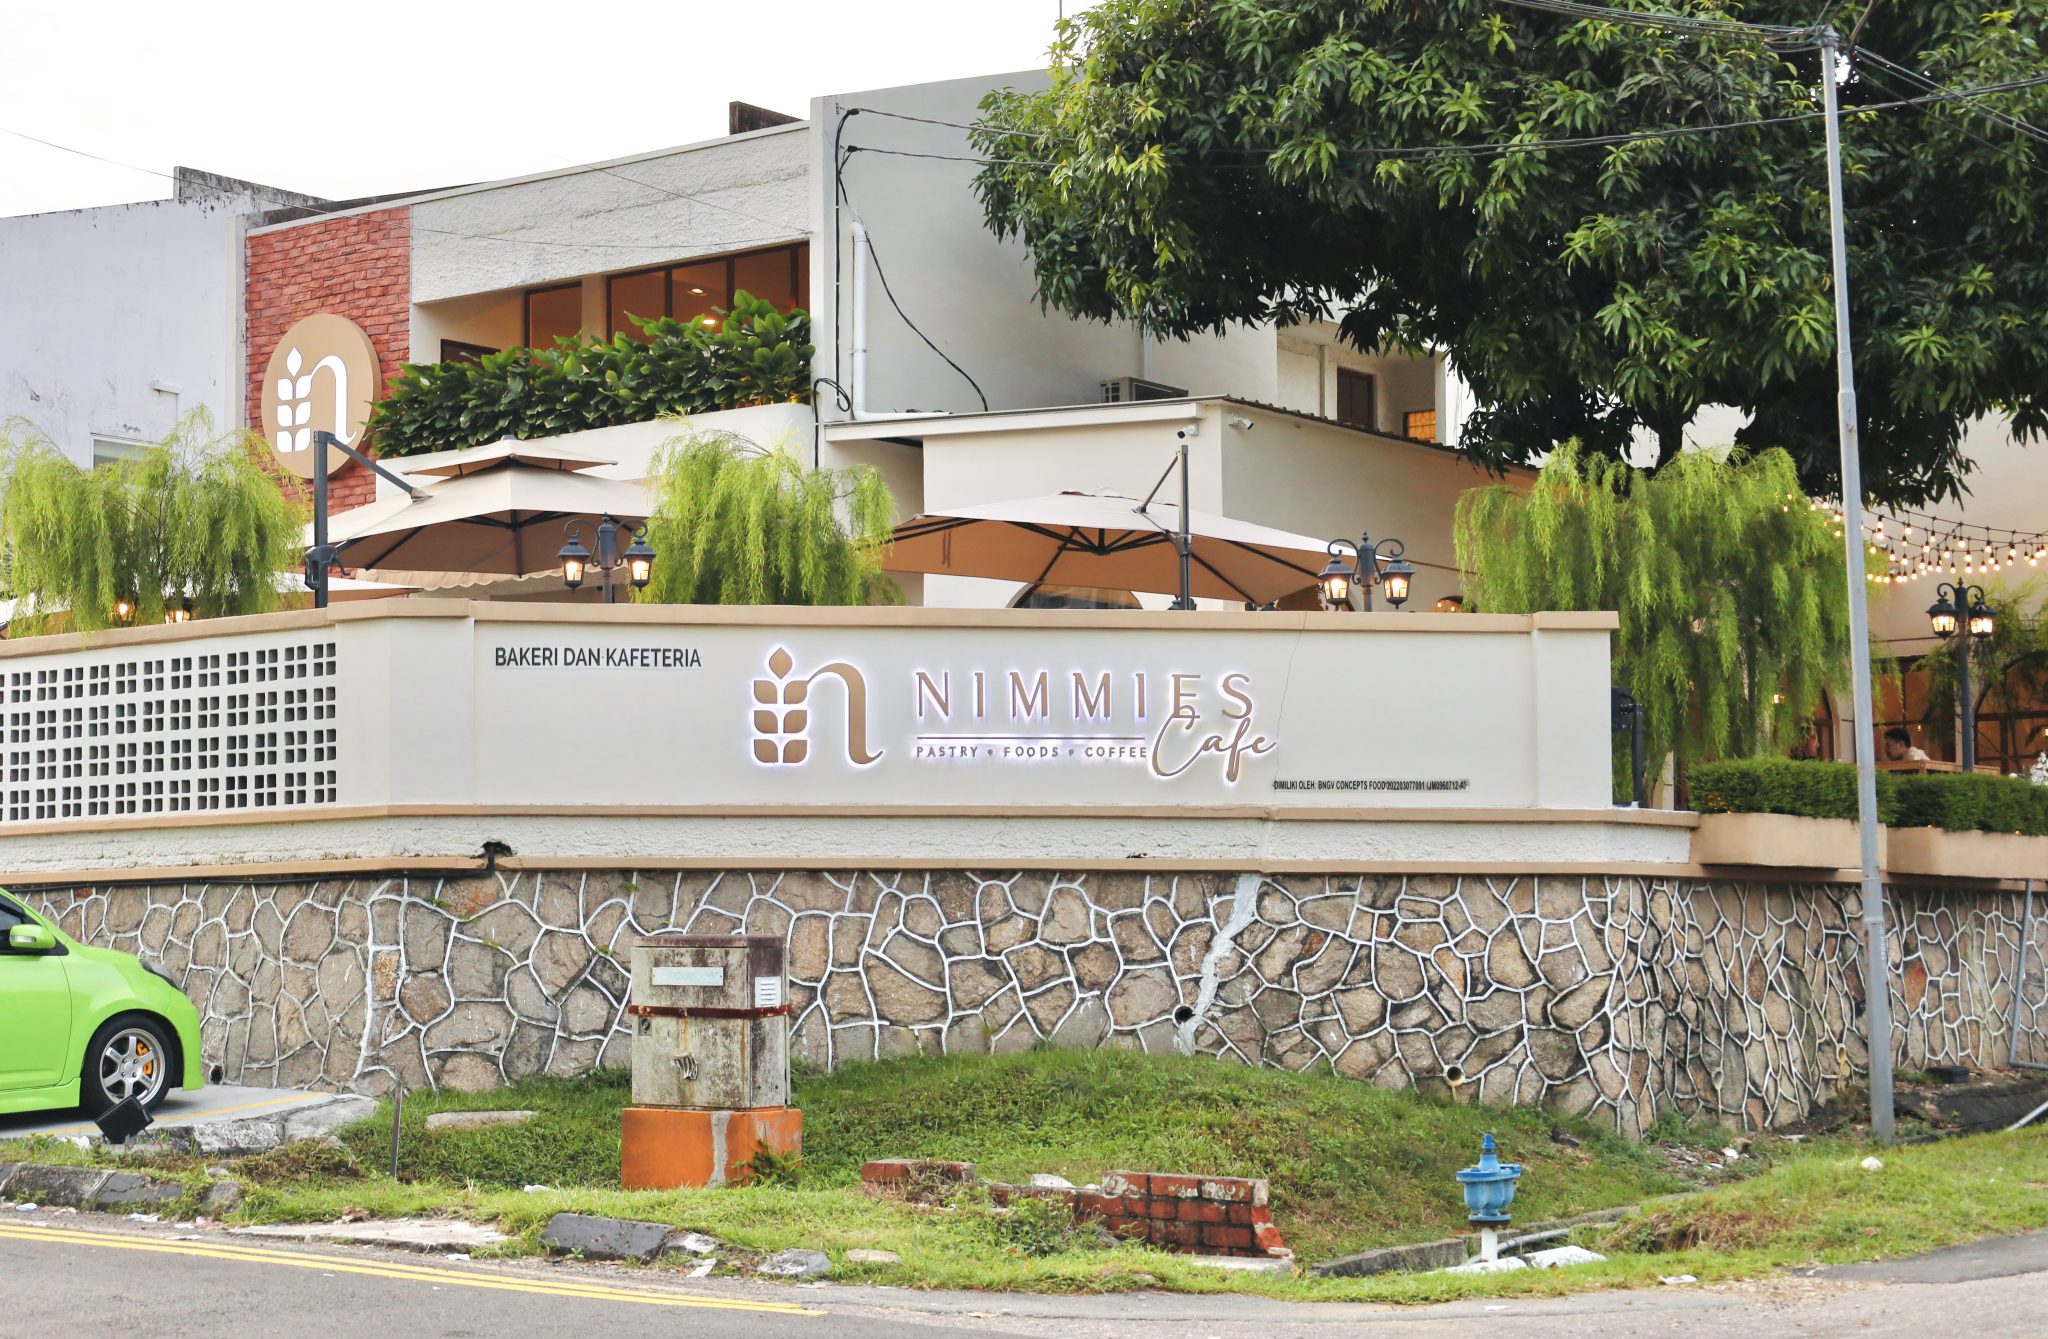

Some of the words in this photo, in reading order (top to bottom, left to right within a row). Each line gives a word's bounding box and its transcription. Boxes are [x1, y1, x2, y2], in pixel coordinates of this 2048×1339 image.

[495, 647, 558, 667] BAKERI
[563, 647, 601, 667] DAN
[606, 647, 702, 668] KAFETERIA
[915, 671, 1253, 719] NIMMIES
[916, 746, 978, 758] PASTRY
[1003, 746, 1060, 759] FOODS
[1085, 746, 1148, 759] COFFEE
[1273, 780, 1298, 790] DIMILIKI
[1298, 780, 1317, 790] OLEH:
[1318, 780, 1335, 790] BNGV
[1335, 780, 1368, 790] CONCEPTS
